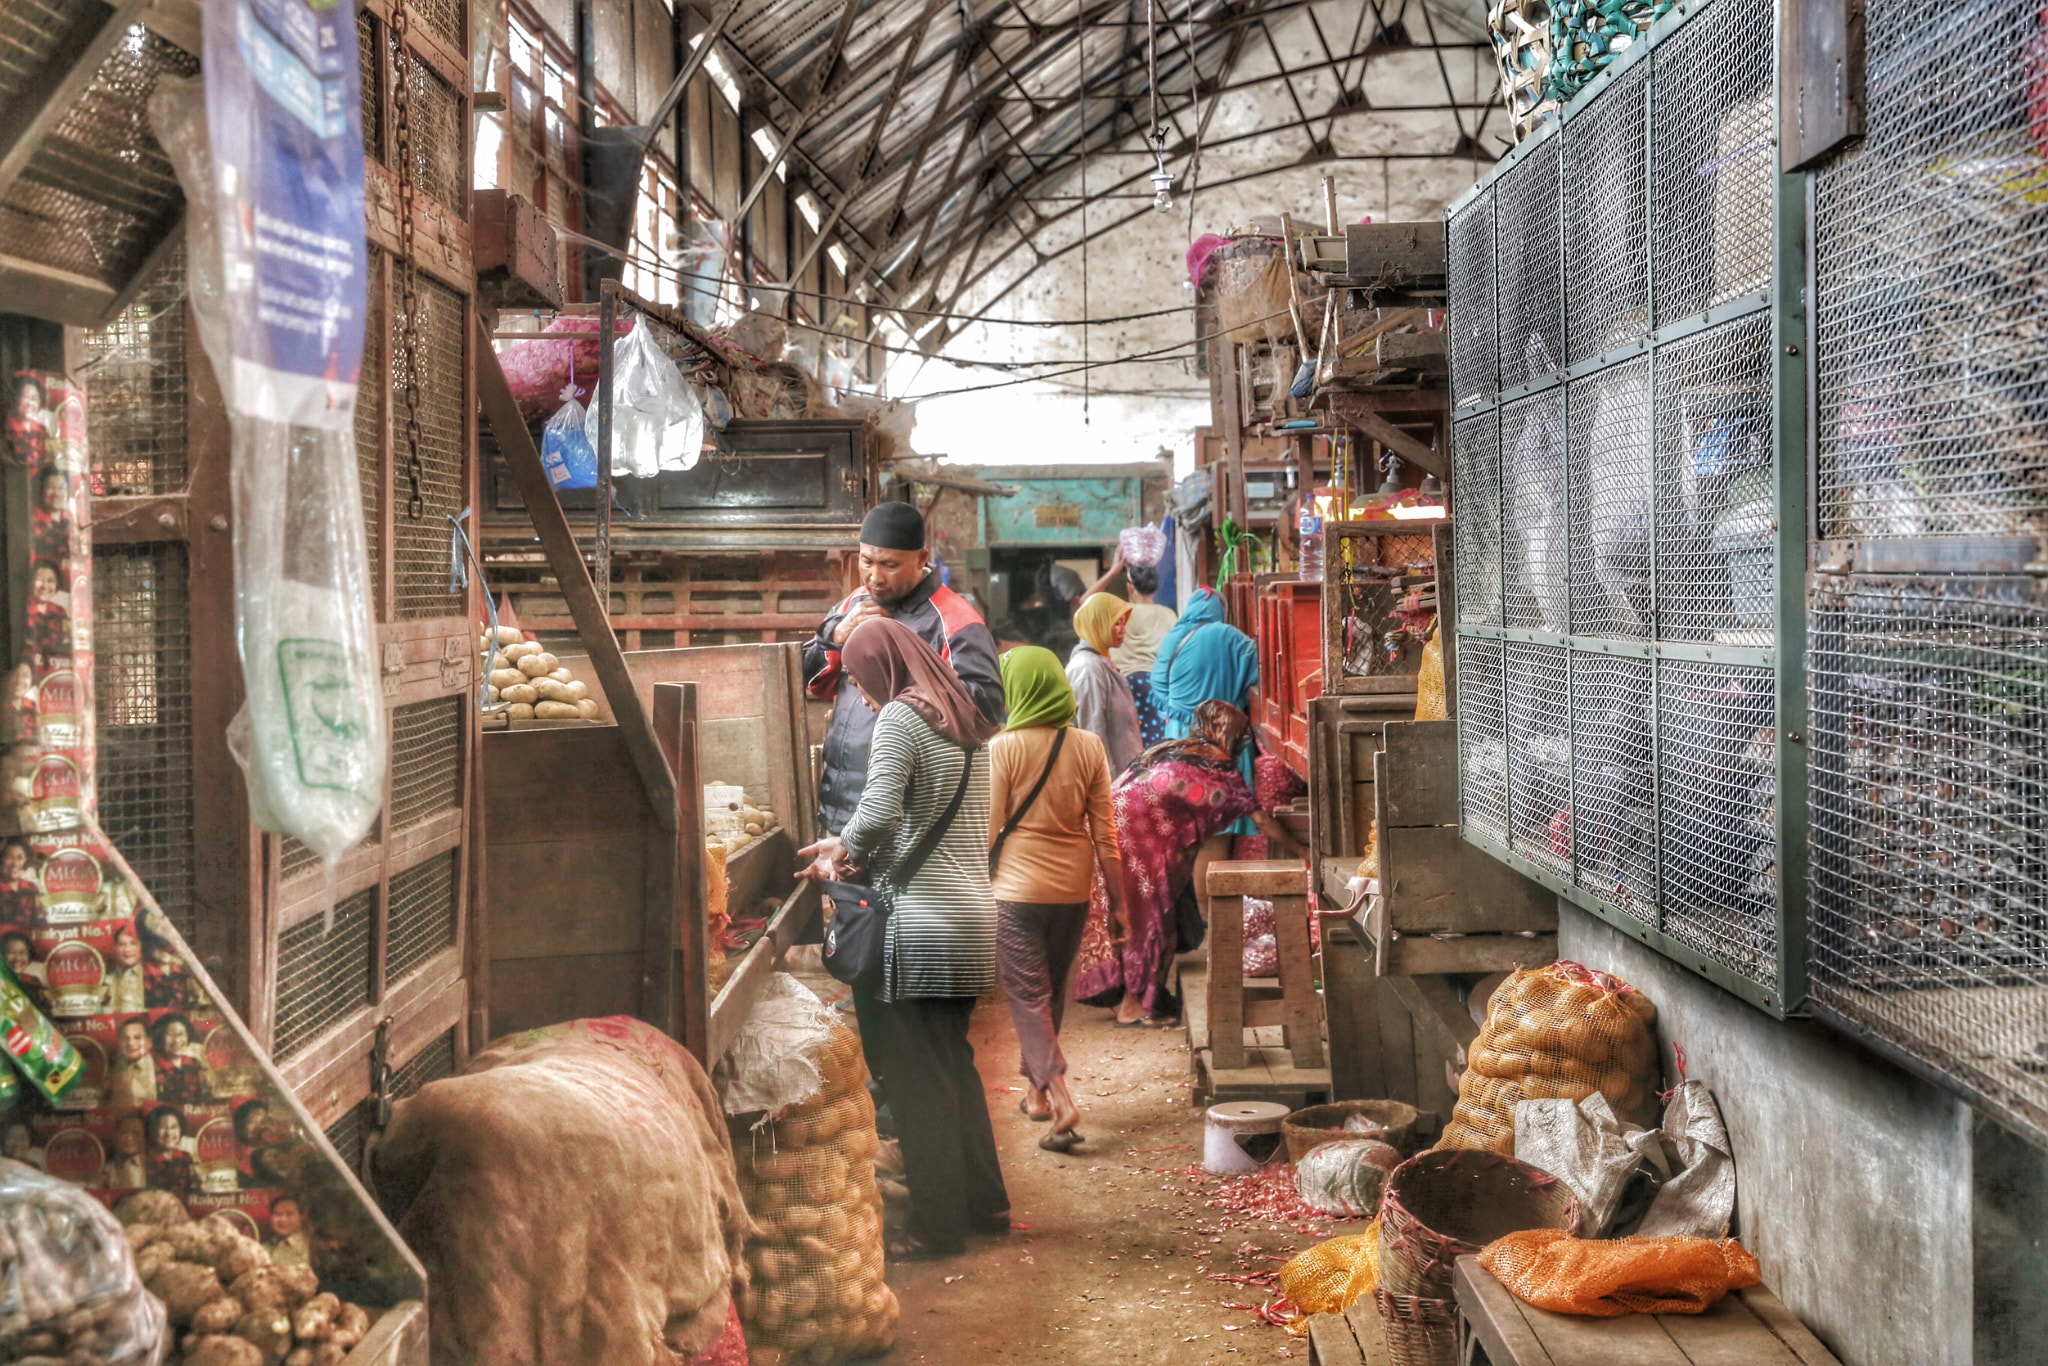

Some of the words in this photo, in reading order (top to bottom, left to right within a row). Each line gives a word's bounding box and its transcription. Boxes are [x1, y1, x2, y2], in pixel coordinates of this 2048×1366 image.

[30, 834, 78, 848] Rakyat
[82, 924, 112, 937] No.1
[86, 1018, 116, 1031] No.1
[188, 1194, 235, 1208] Rakyat
